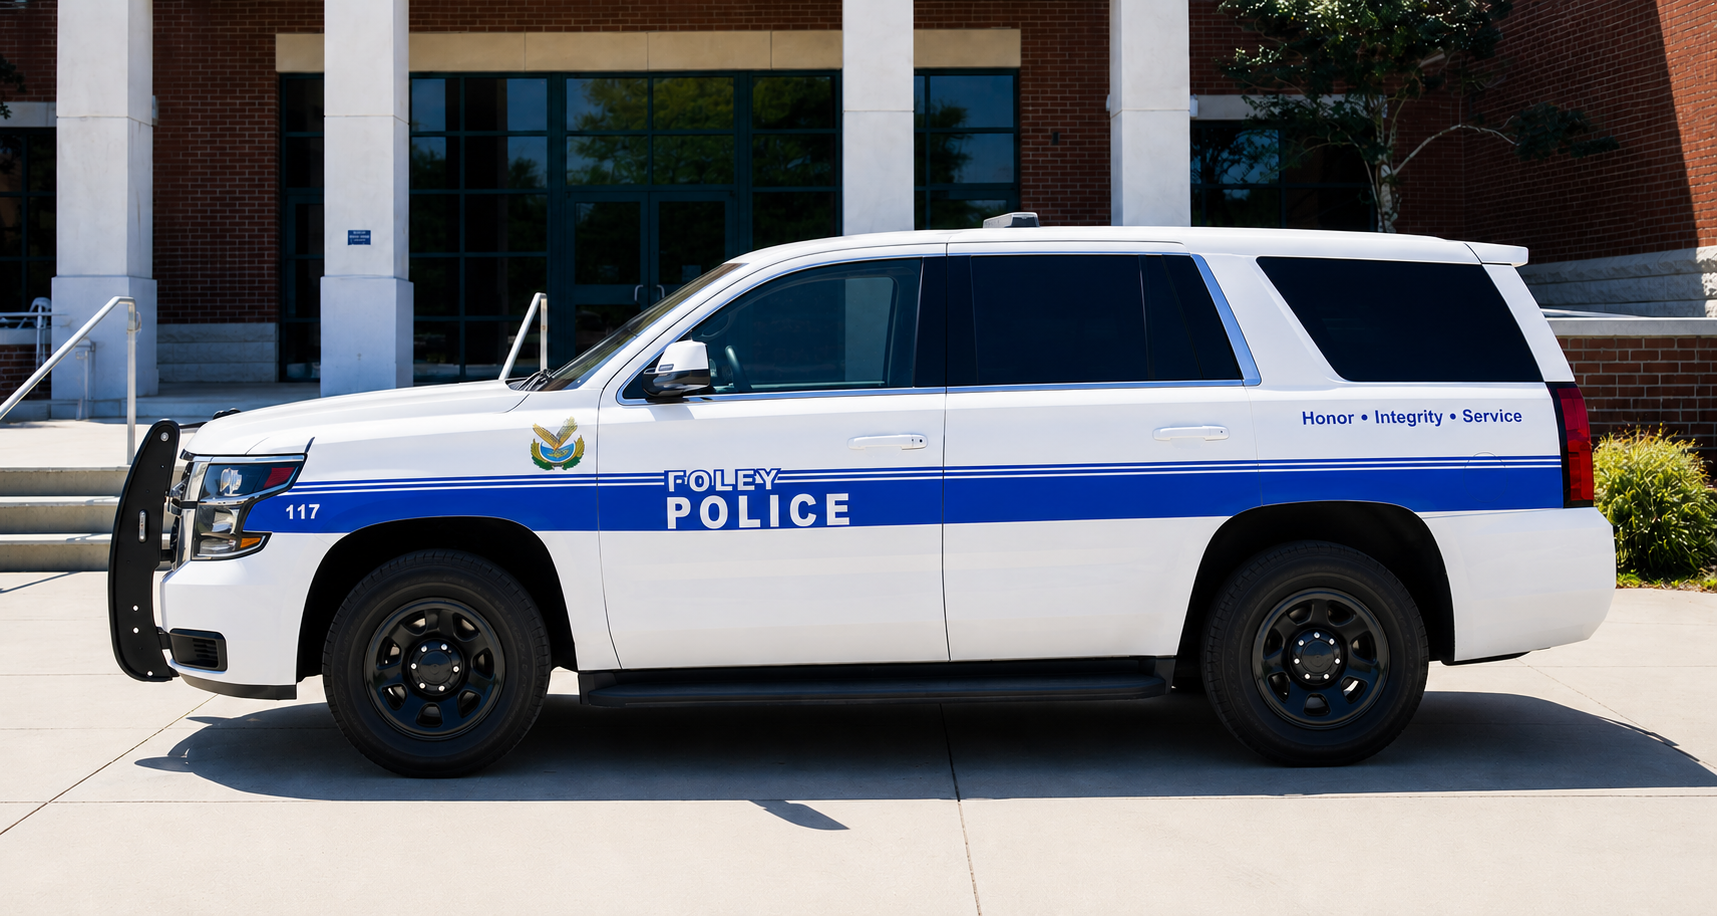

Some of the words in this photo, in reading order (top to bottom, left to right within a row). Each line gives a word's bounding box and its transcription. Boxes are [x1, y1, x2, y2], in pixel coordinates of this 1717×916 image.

[1302, 411, 1354, 425] Honor
[1375, 409, 1443, 427] Integrity
[1462, 408, 1523, 423] Service
[666, 469, 779, 493] FOLEY
[285, 503, 321, 520] 117
[667, 493, 850, 530] POLICE
